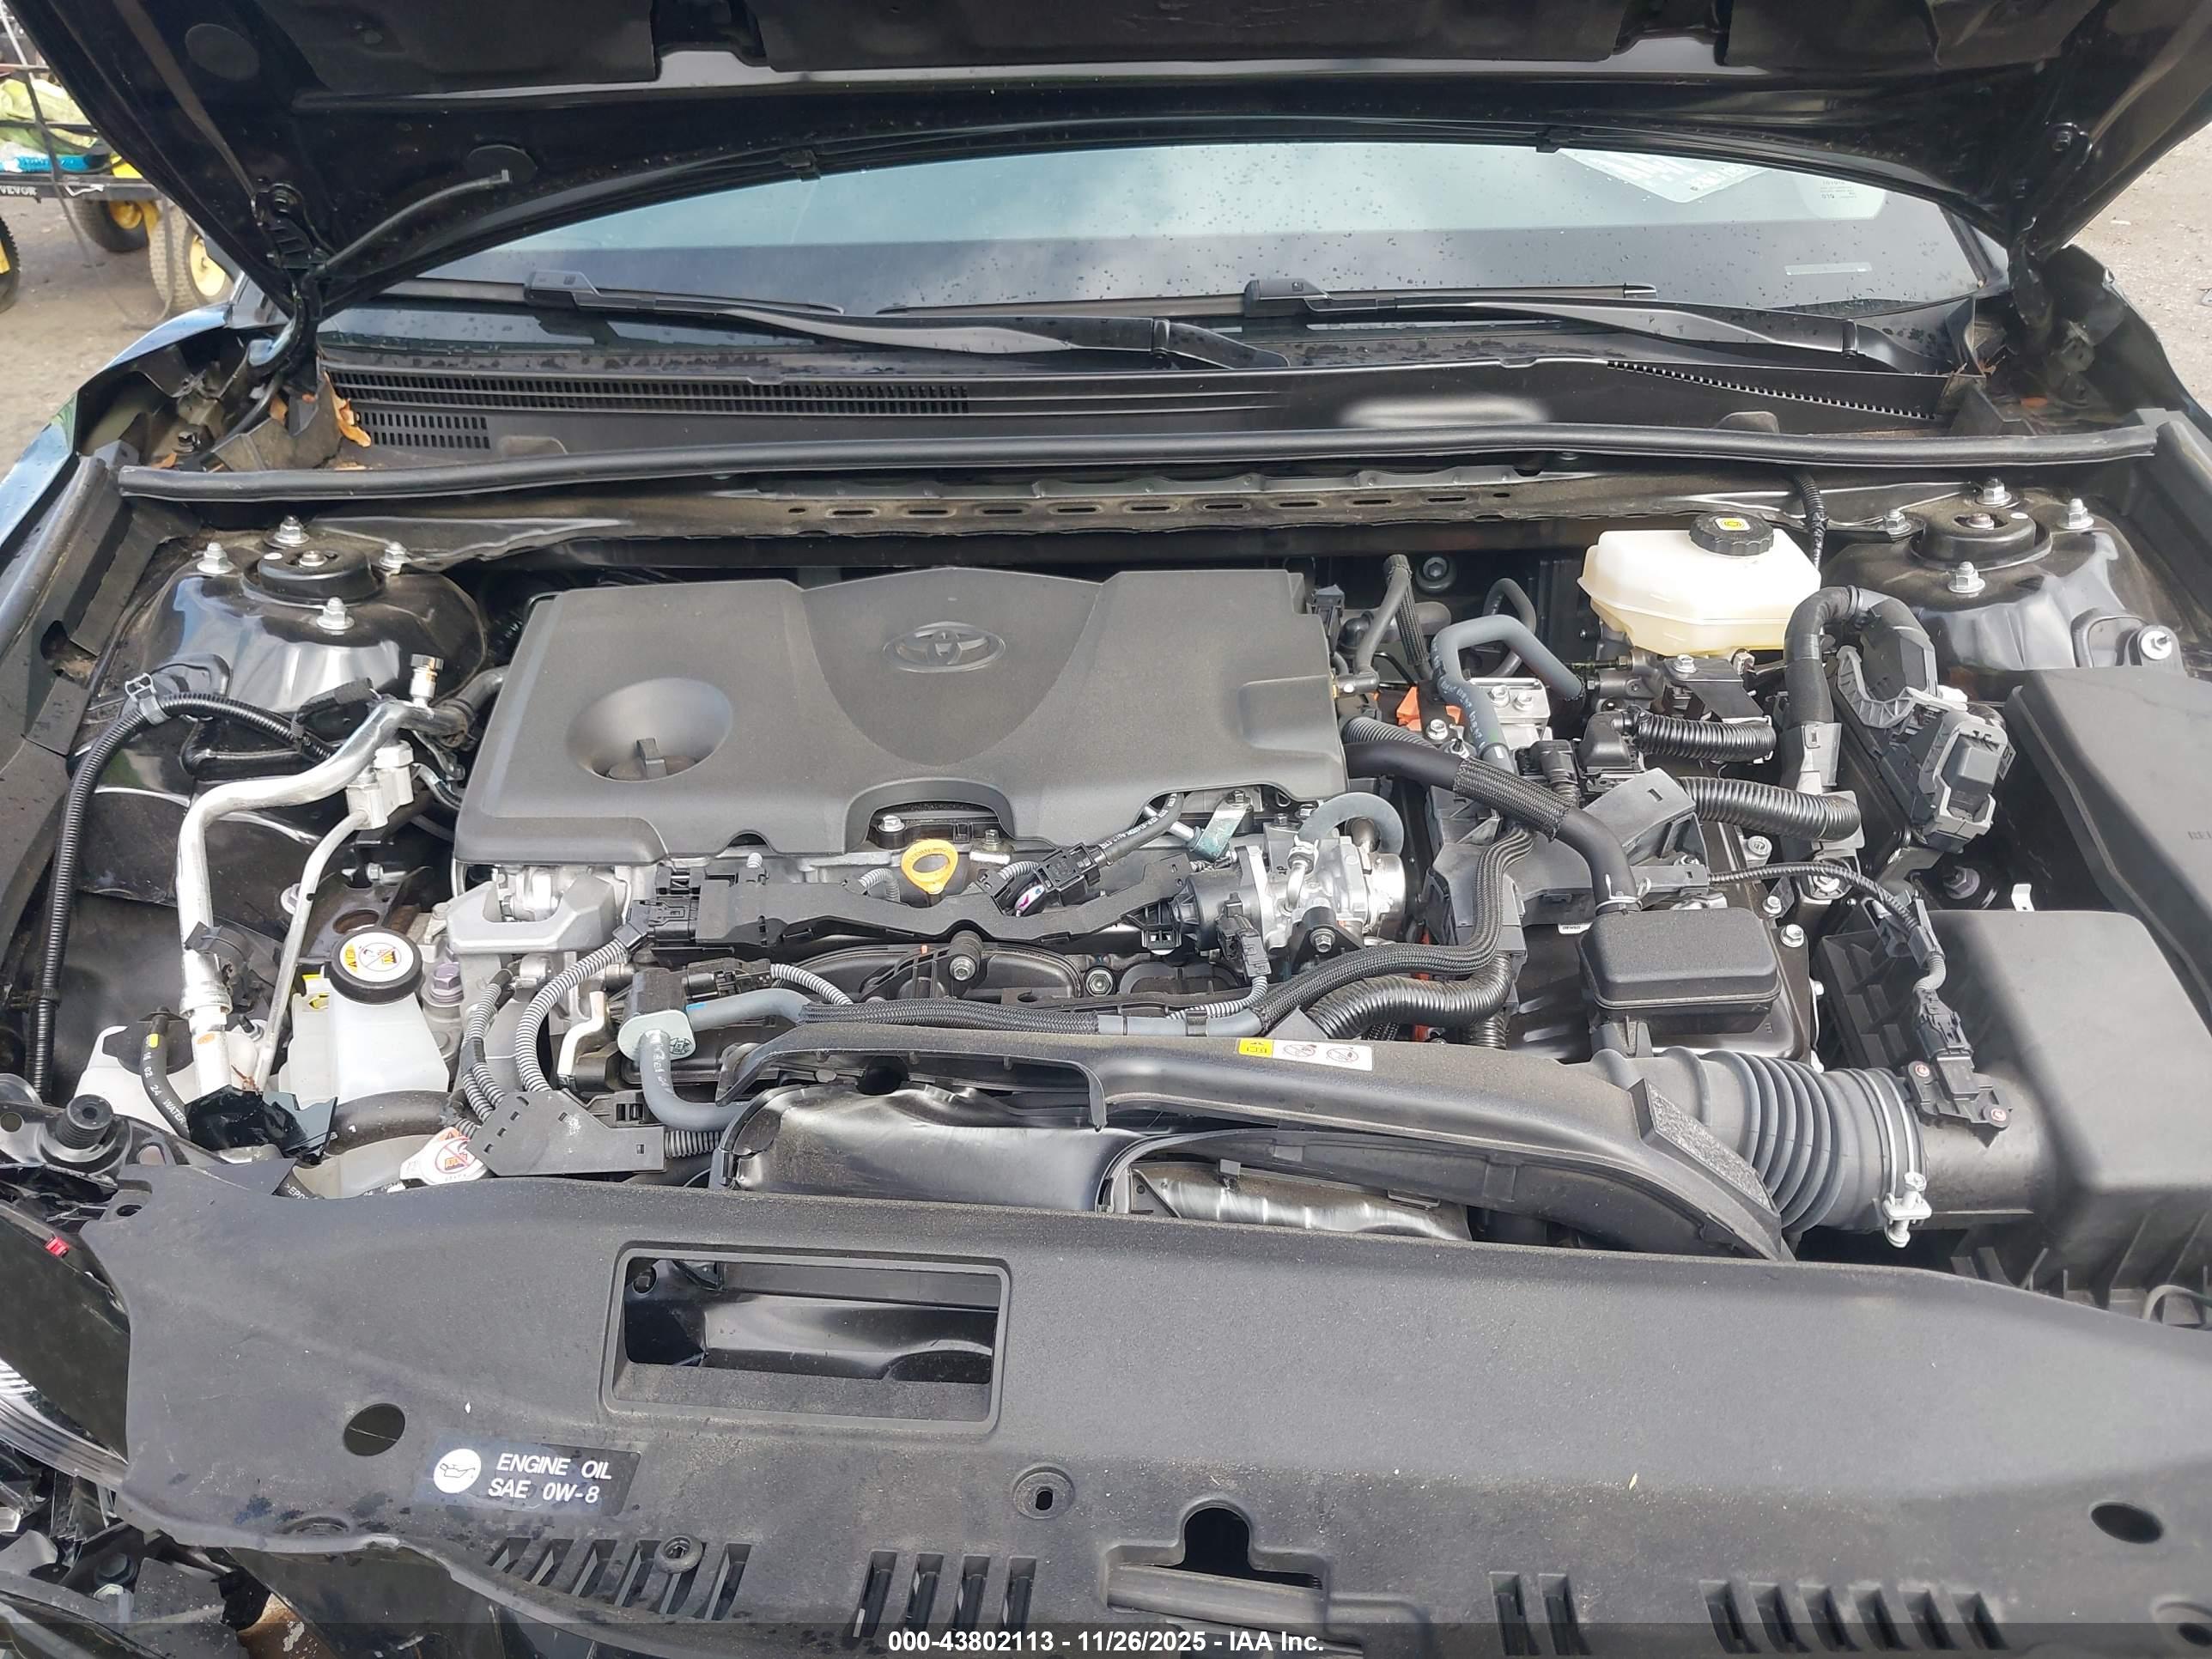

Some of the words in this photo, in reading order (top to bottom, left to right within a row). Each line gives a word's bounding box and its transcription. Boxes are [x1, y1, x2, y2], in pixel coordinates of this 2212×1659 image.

[149, 1085, 163, 1097] 24
[163, 1098, 186, 1125] WATER
[496, 1453, 570, 1476] ENGINE
[580, 1460, 612, 1480] OIL
[488, 1478, 532, 1499] SAE
[543, 1482, 600, 1504] 0W-8
